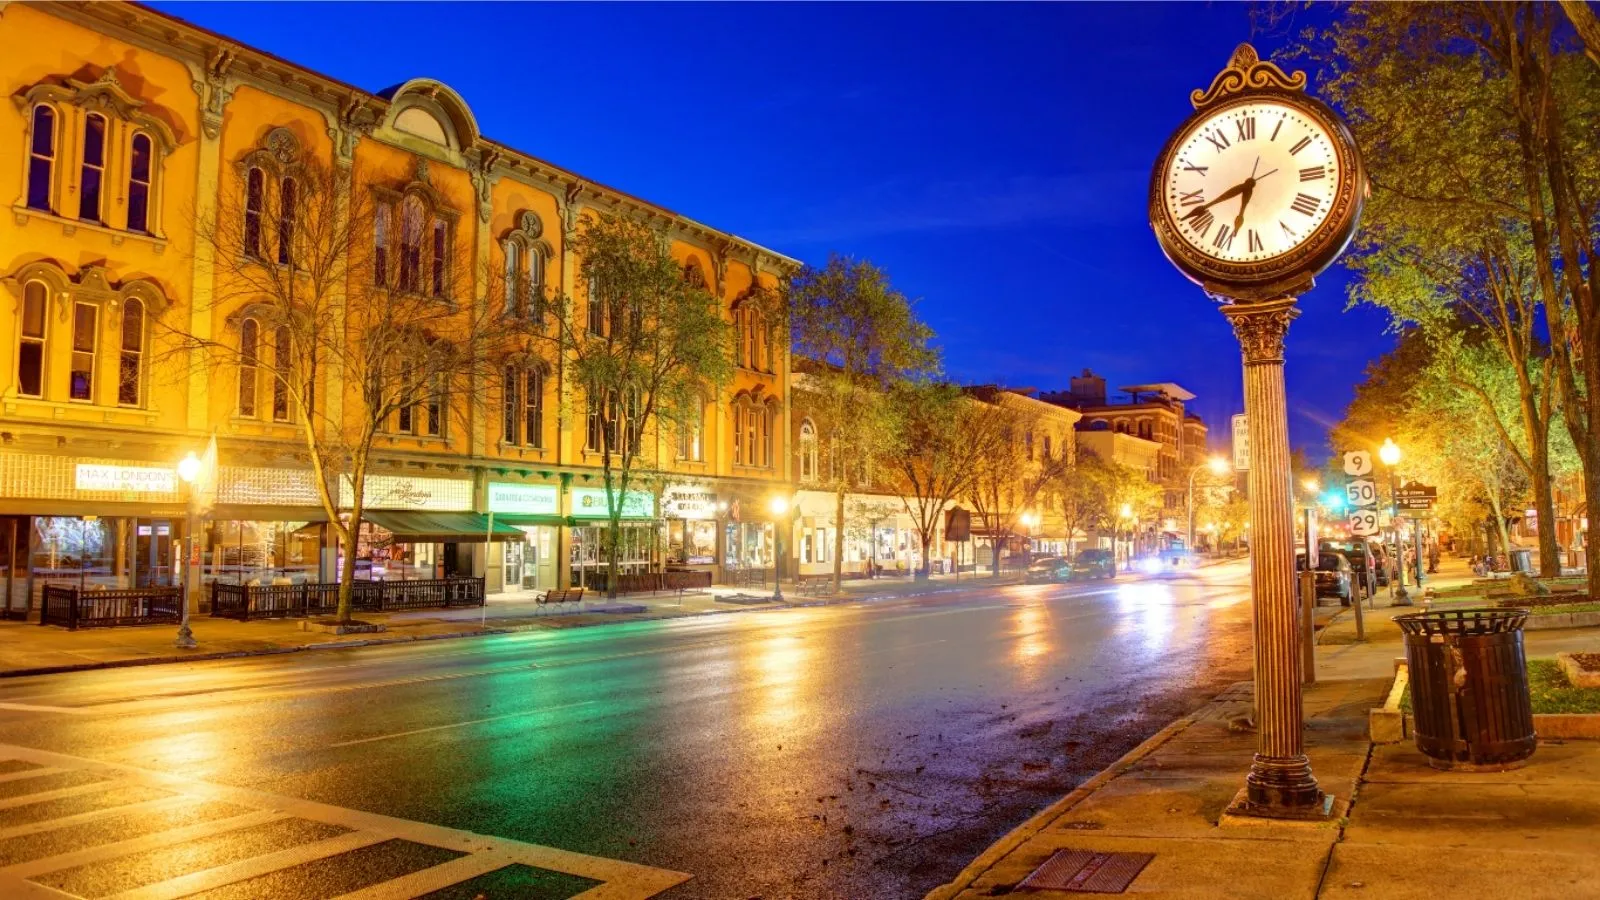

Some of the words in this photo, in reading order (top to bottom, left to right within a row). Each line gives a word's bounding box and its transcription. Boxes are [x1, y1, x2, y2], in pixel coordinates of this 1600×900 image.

[1236, 117, 1255, 142] XII
[1270, 119, 1283, 142] I
[1205, 128, 1231, 154] XI
[1289, 135, 1313, 156] II
[1183, 161, 1209, 177] X
[1299, 165, 1325, 182] III
[1179, 188, 1205, 207] IX
[1212, 223, 1235, 251] VII
[1279, 219, 1297, 239] V
[1248, 229, 1264, 252] VI
[1352, 456, 1363, 471] 9
[80, 468, 109, 479] MAX
[1349, 485, 1373, 501] 50
[1352, 515, 1376, 531] 29
